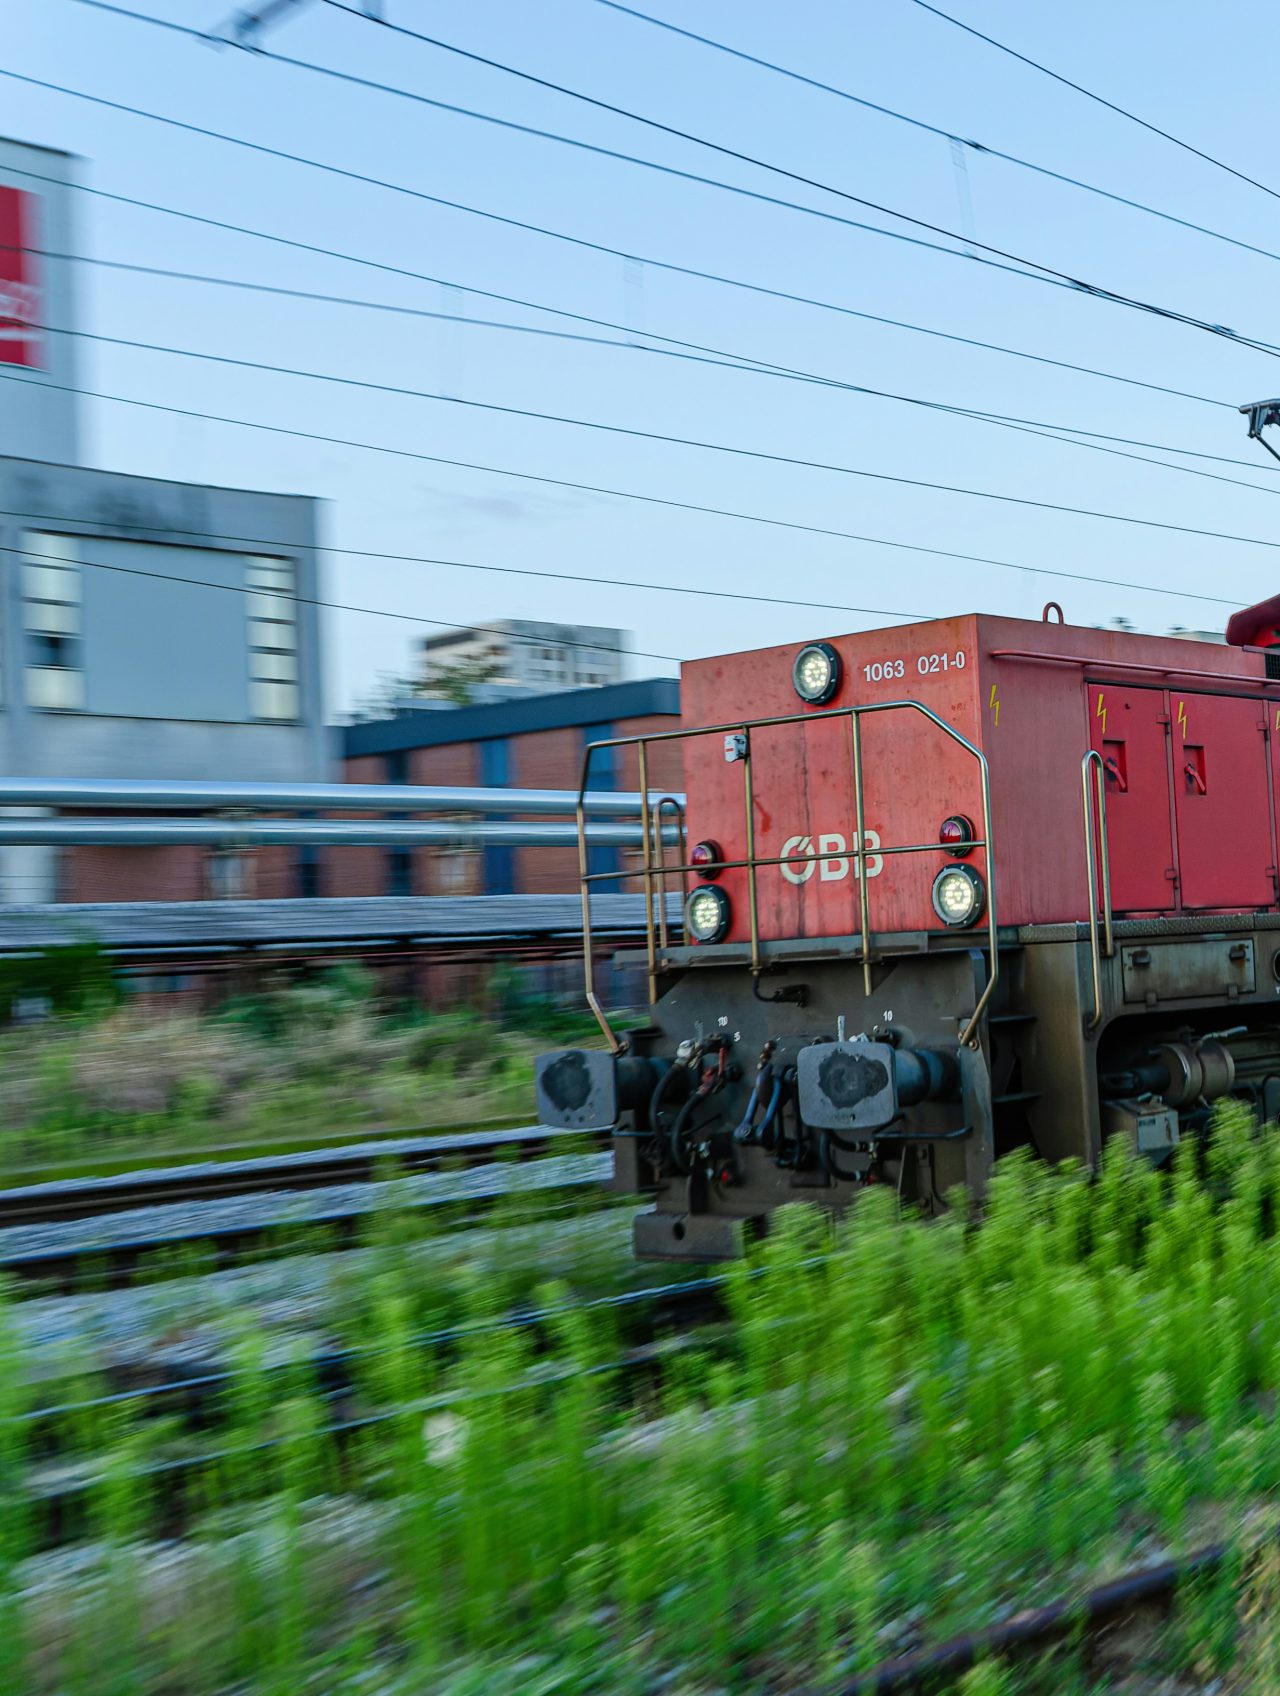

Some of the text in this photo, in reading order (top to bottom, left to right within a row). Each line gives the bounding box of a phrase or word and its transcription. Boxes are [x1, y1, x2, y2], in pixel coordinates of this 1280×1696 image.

[863, 651, 966, 682] 1063 021-0
[779, 829, 884, 885] ÖBB
[882, 1009, 893, 1022] 10
